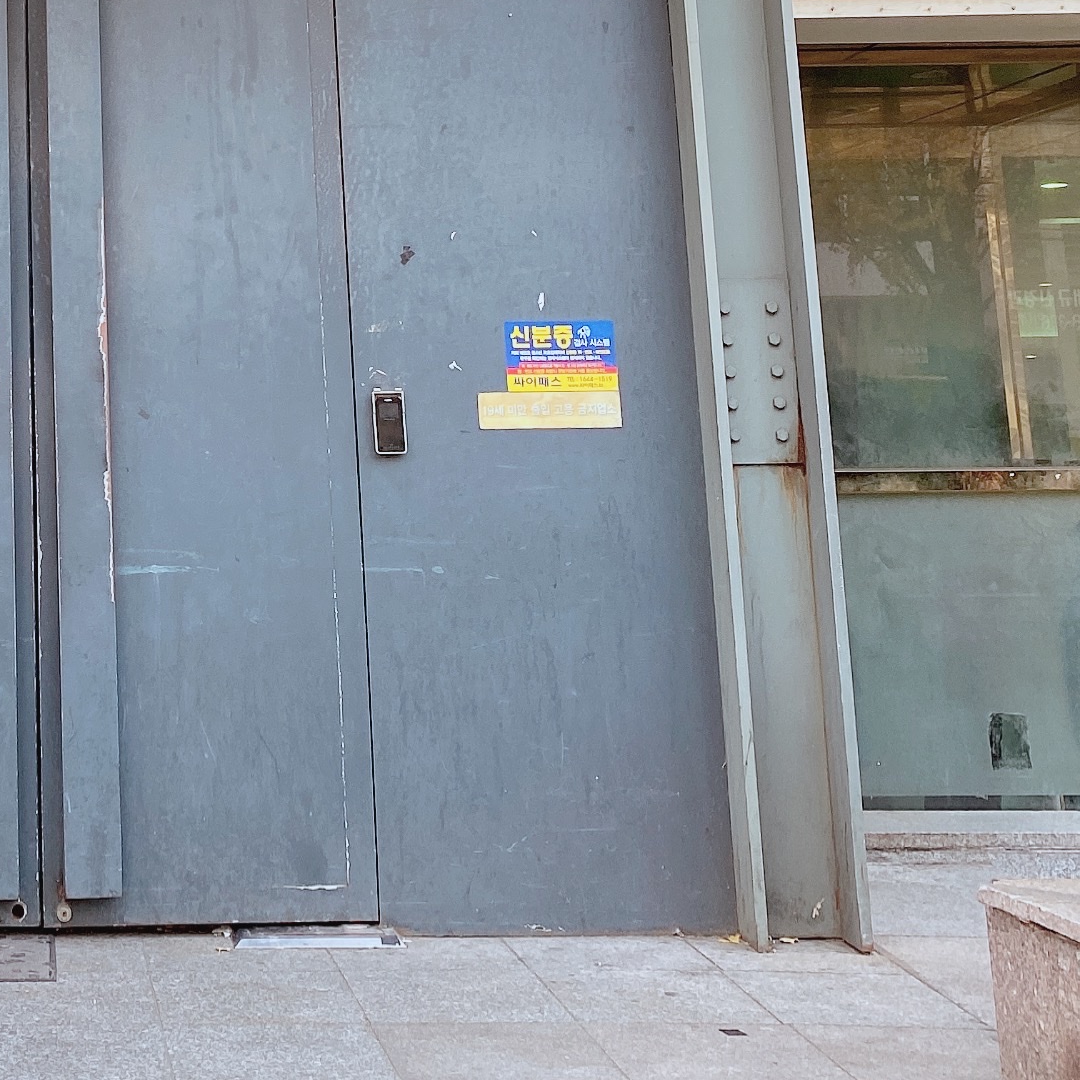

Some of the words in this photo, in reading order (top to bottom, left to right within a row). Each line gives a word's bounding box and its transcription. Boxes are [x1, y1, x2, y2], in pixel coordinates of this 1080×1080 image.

[510, 324, 574, 349] 신분증
[589, 338, 611, 347] 시스템
[513, 376, 562, 388] 싸이패스
[483, 404, 505, 417] 19세
[507, 403, 527, 417] 미만
[554, 402, 575, 416] 고용
